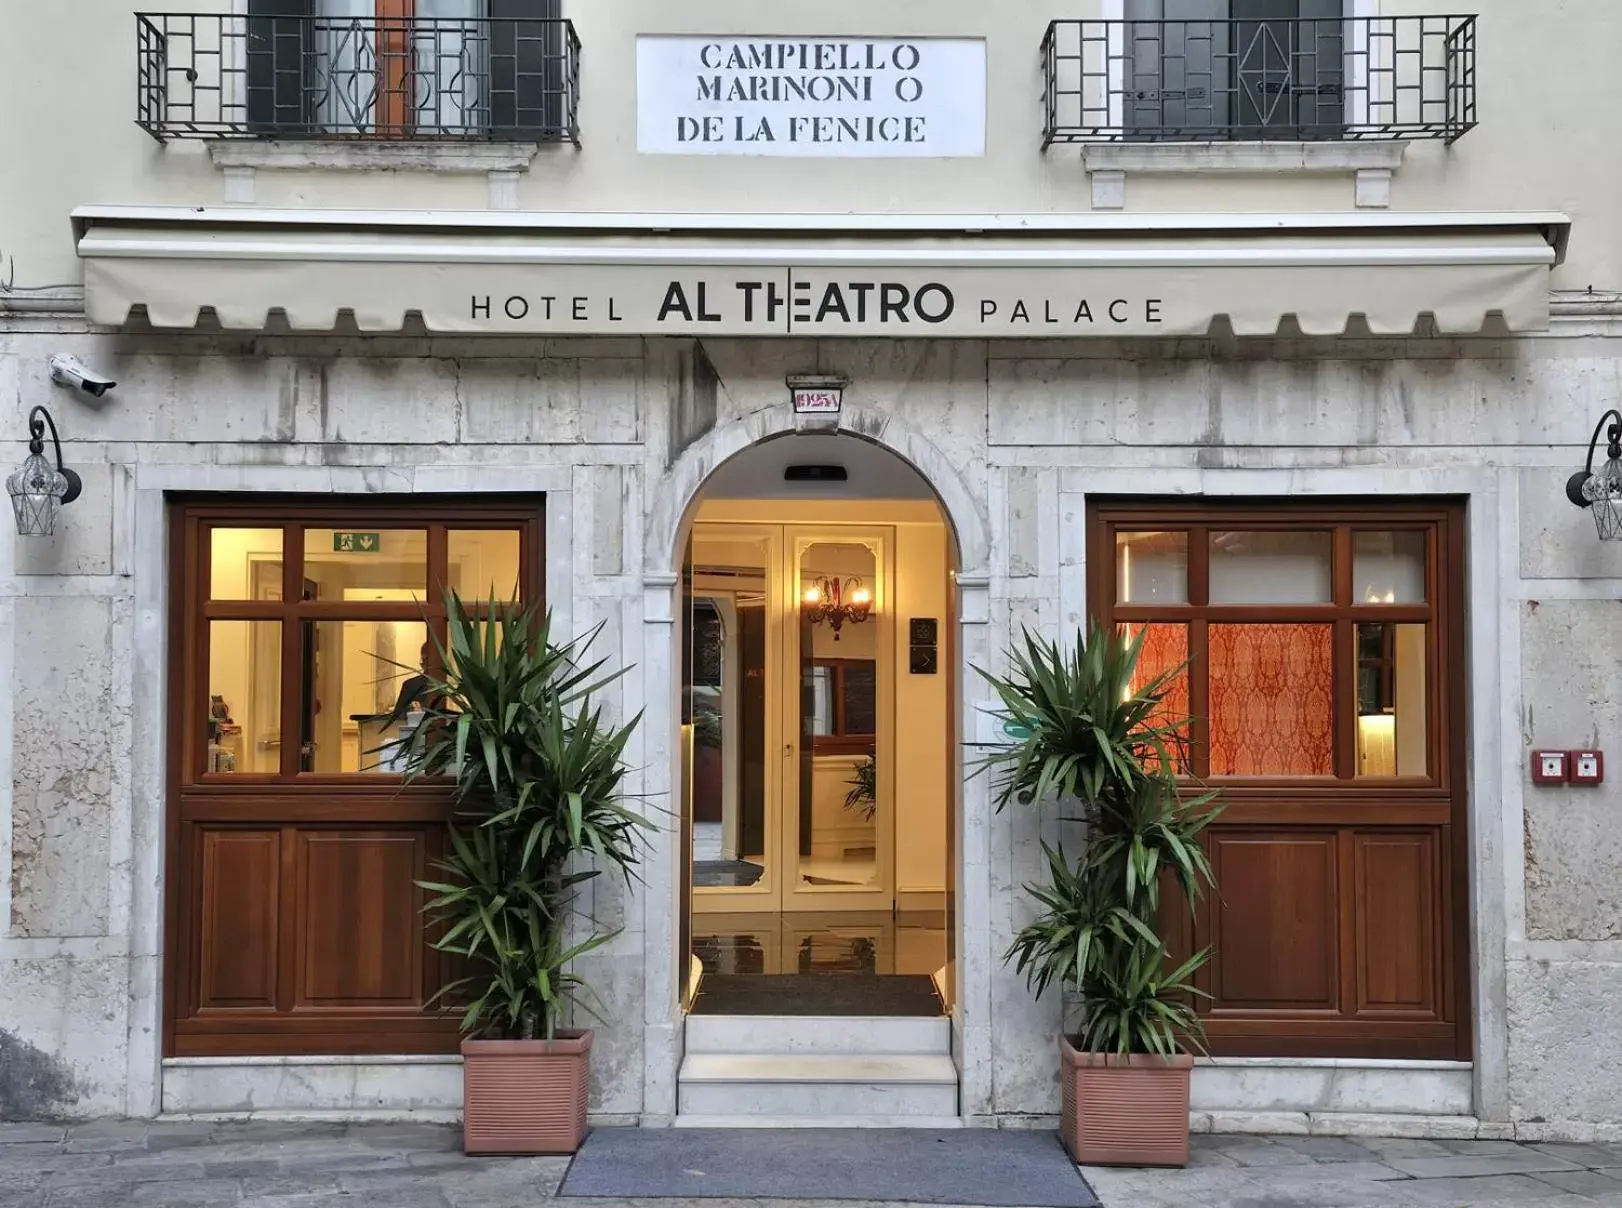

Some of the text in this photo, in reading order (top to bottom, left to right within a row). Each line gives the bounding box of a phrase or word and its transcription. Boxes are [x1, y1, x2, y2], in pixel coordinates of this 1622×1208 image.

[700, 43, 920, 71] CAMPIELLO
[697, 75, 923, 102] MARINONI O
[677, 116, 926, 143] DE LA FENICE
[471, 281, 1163, 324] HOTEL AL THEATRO PALACE
